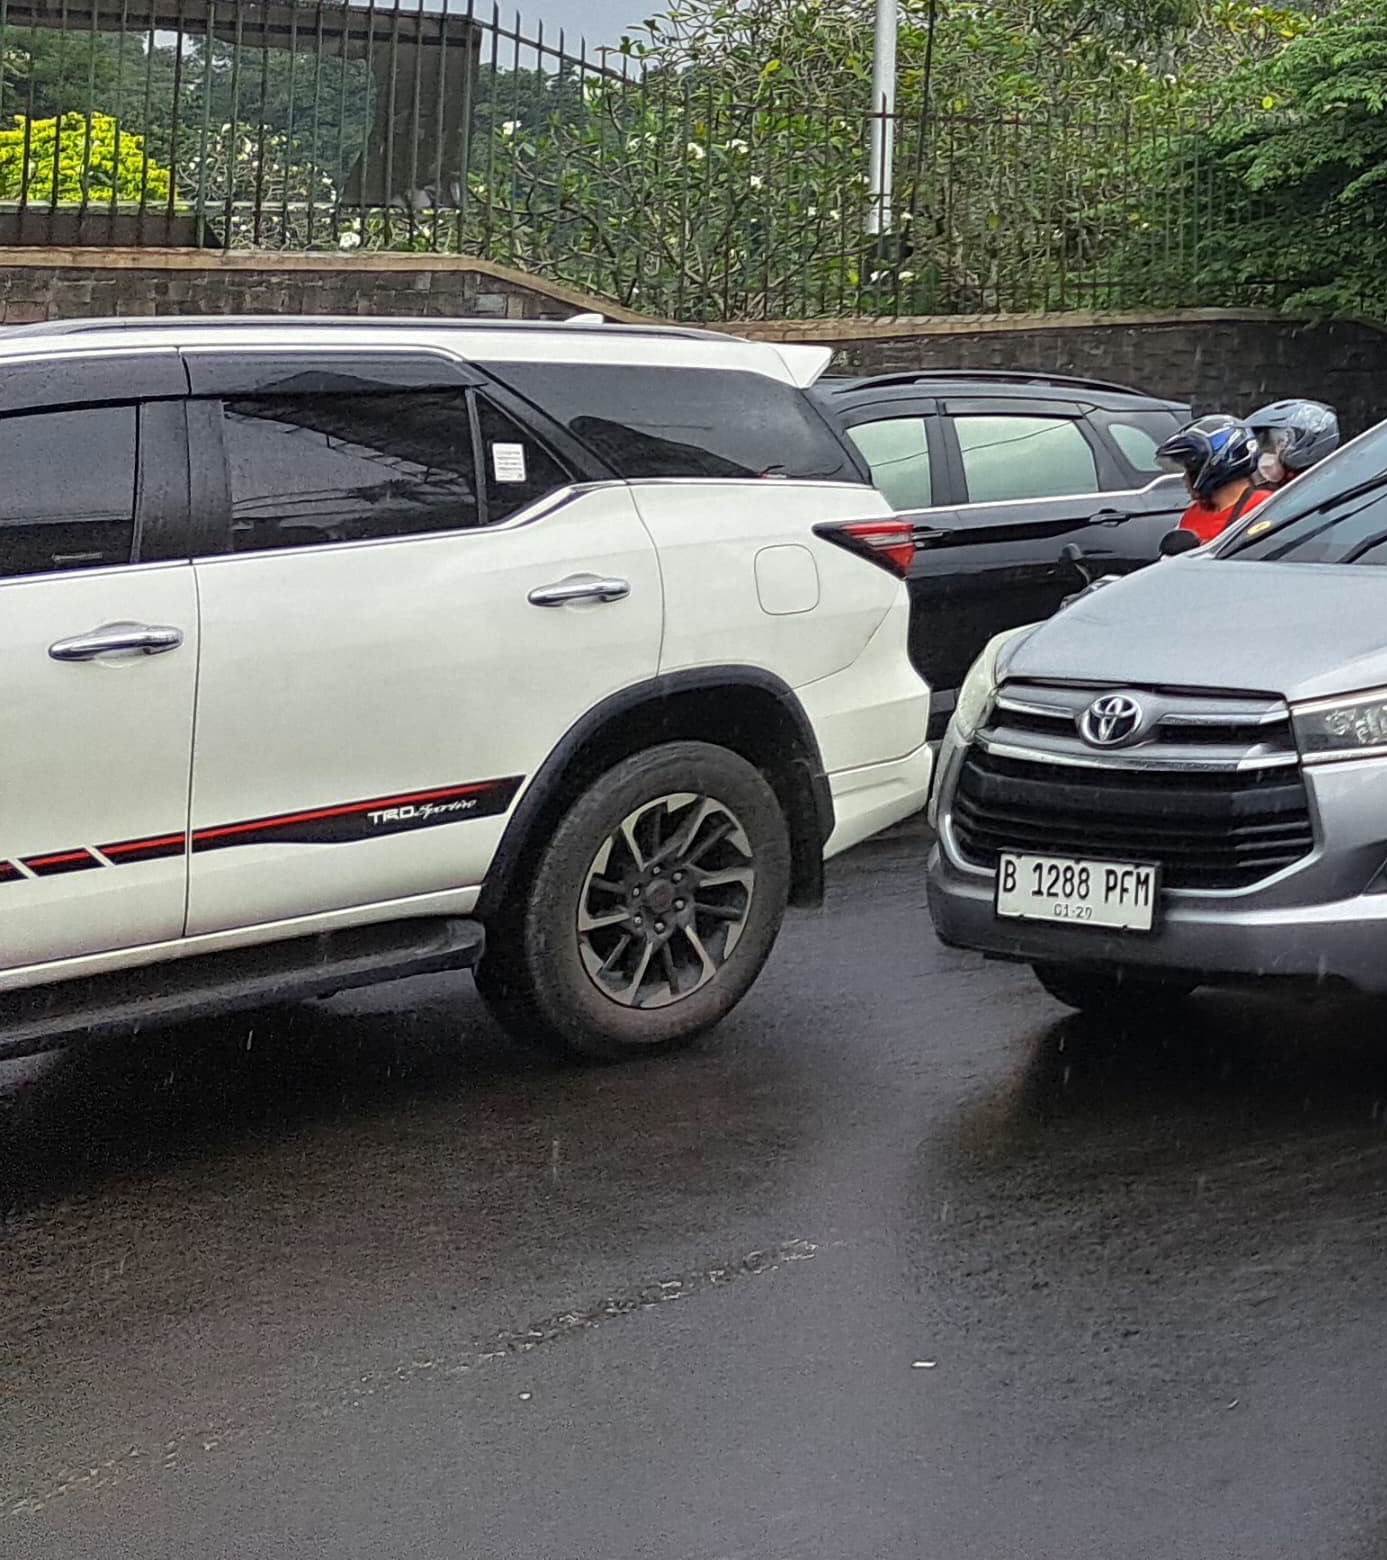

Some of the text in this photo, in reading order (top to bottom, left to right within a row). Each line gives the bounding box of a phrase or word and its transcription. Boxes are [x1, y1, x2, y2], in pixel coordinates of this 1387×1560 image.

[367, 805, 415, 824] TRD
[1003, 860, 1150, 906] B 1288 PFM
